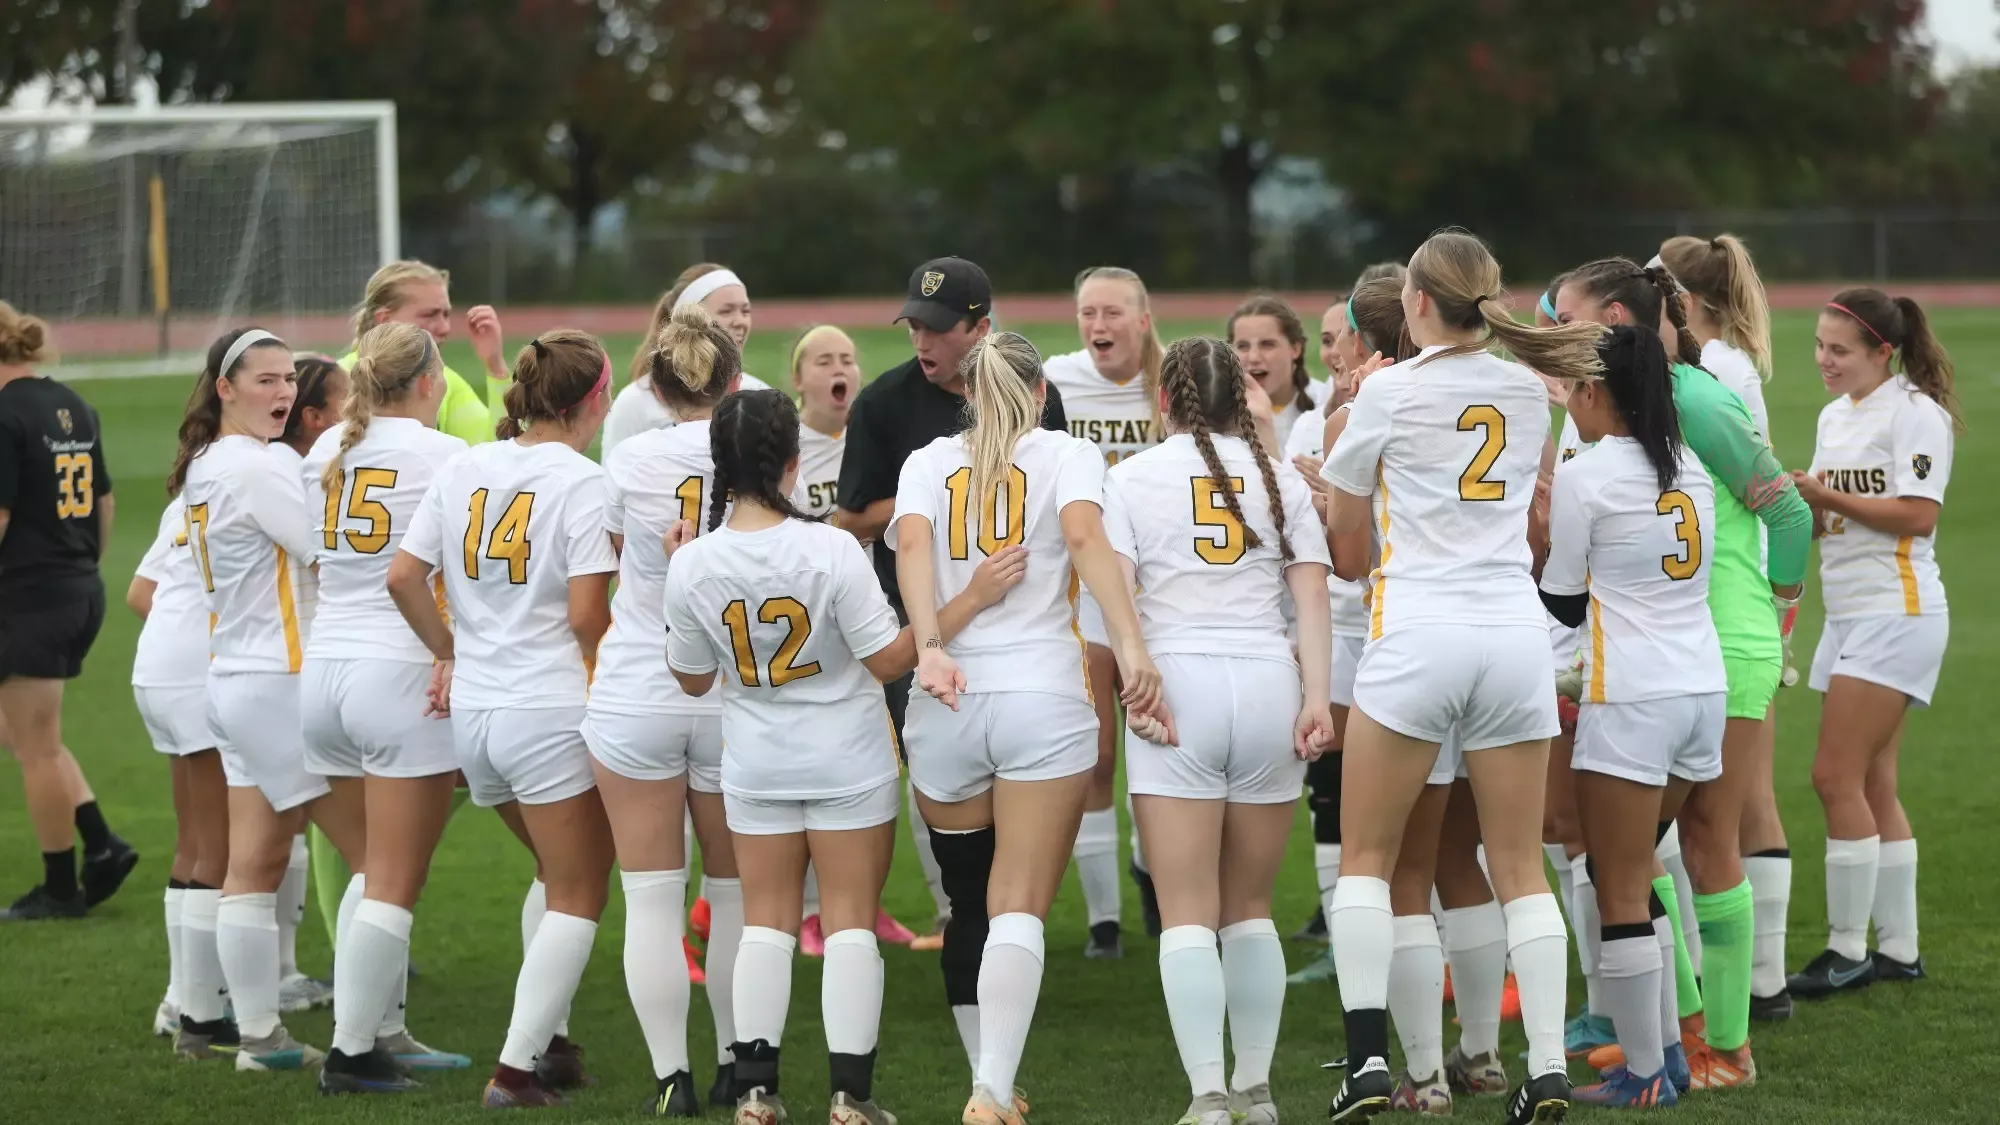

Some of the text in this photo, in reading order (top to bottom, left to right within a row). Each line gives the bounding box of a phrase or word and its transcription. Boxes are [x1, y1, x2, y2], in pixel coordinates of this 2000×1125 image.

[1070, 419, 1165, 445] USTAV
[1456, 404, 1507, 502] 2
[55, 451, 93, 520] 33
[321, 466, 399, 555] 15
[945, 463, 1028, 561] 10
[1190, 475, 1247, 565] 5
[463, 486, 536, 585] 14
[1655, 488, 1702, 581] 3
[721, 595, 823, 688] 12
